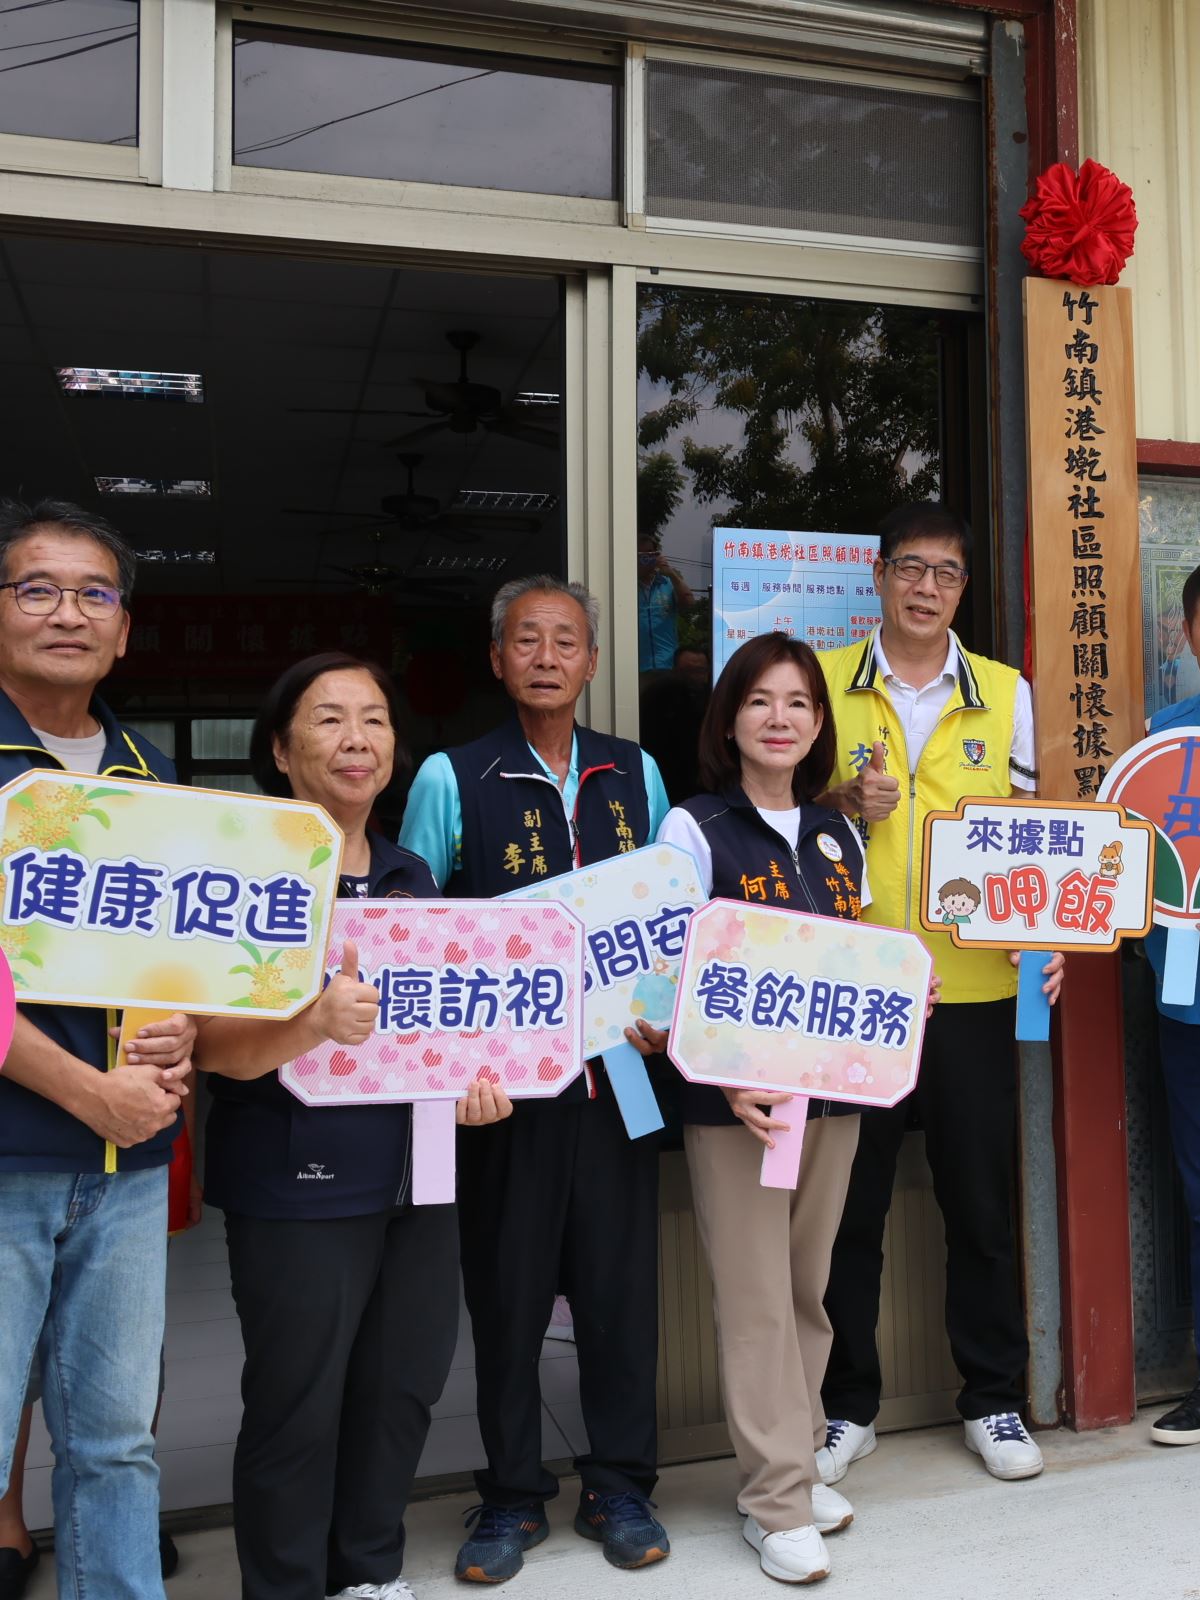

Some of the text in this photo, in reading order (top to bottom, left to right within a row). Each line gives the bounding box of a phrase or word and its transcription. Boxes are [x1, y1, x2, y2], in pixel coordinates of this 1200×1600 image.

[724, 540, 880, 564] 竹南鎮港墘社區照顧關懷
[762, 582, 802, 594] 服務時間
[806, 584, 845, 596] 服務地點
[855, 586, 881, 597] 服務
[503, 842, 526, 875] 李
[523, 808, 549, 876] 副主席
[966, 818, 1085, 858] 來據點
[8, 851, 312, 944] 健康促進
[740, 873, 768, 901] 何
[769, 859, 791, 900] 主席
[825, 876, 848, 917] 竹南
[985, 867, 1118, 934] 呷飯
[584, 906, 695, 992] 問安
[322, 966, 565, 1030] 懷訪視
[696, 961, 914, 1048] 餐飲服務
